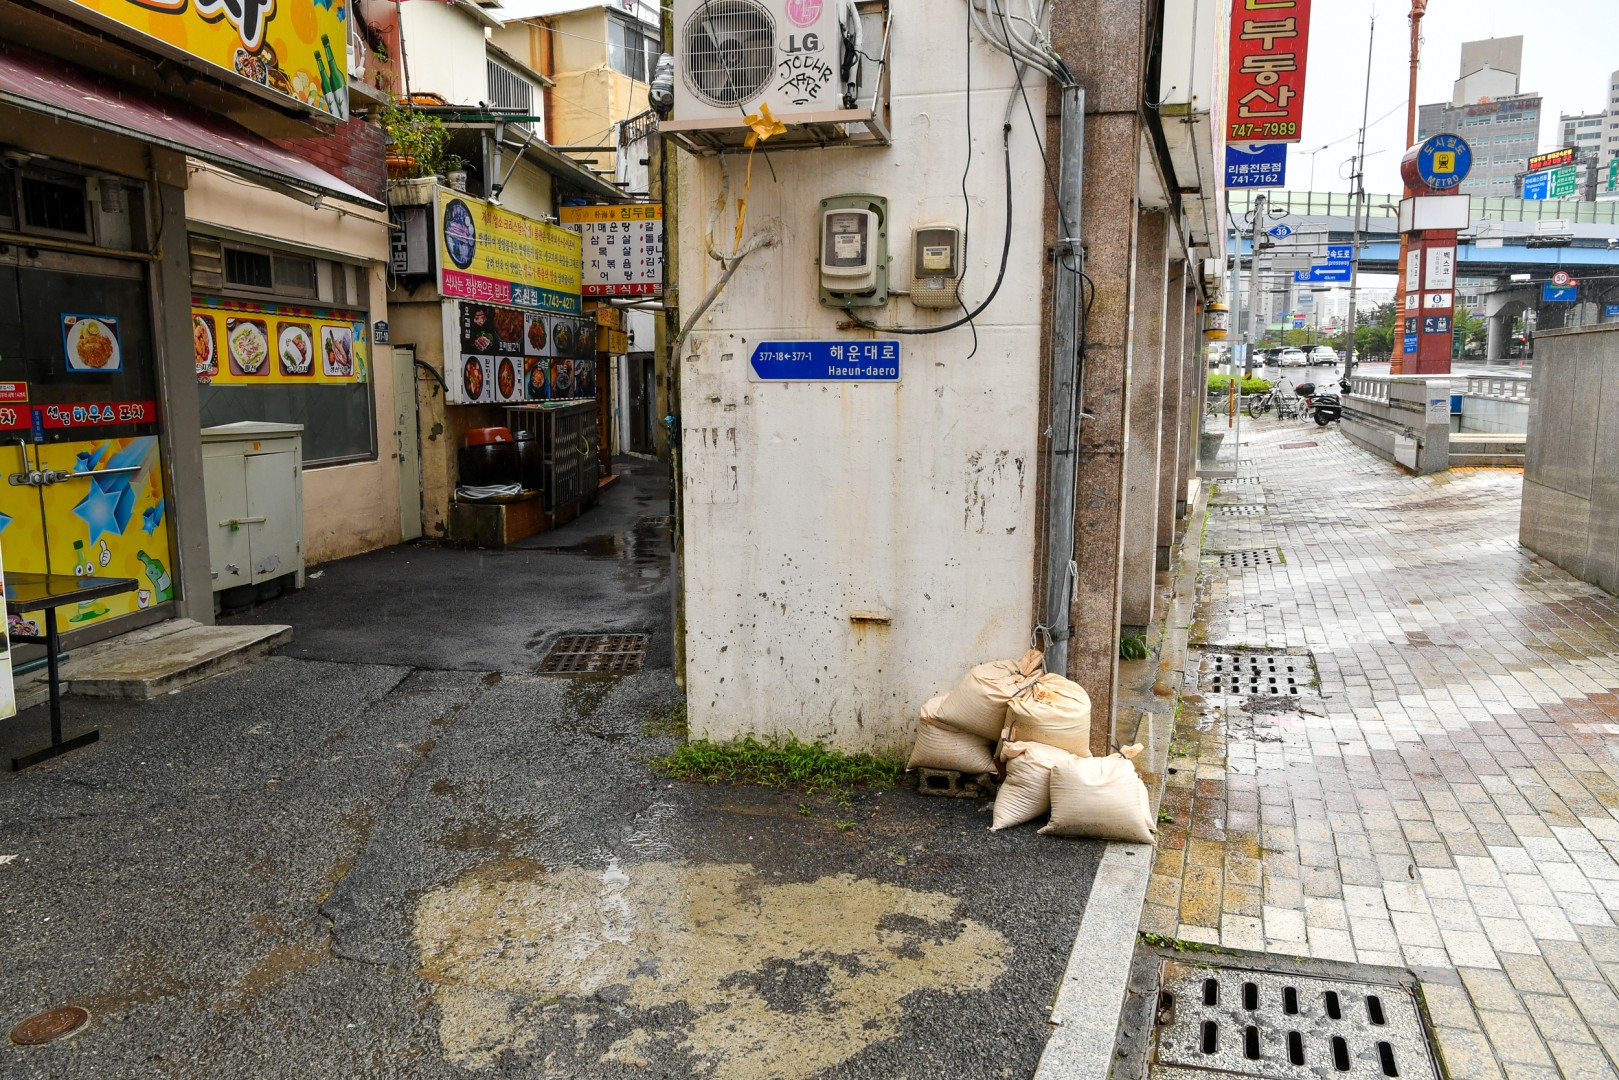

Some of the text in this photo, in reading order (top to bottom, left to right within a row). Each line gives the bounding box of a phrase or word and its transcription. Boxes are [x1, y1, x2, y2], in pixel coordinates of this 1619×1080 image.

[790, 33, 819, 54] LG
[1238, 17, 1298, 118] 부동산
[1231, 122, 1297, 137] 747-7989
[1424, 137, 1466, 156] 도시철도
[1231, 174, 1278, 185] 741-7162
[1426, 174, 1460, 188] METRO
[591, 235, 631, 245] 삼겹살
[1443, 252, 1451, 275] 벡스코
[445, 274, 511, 300] 식사는 정상적으로 됩니다
[514, 287, 576, 310] 초원집 T.743-4271
[464, 306, 472, 339] 오겹살
[759, 352, 812, 361] 377-18 377-1
[830, 345, 896, 362] 해운대로
[828, 366, 896, 376] Haeun-daero
[73, 404, 116, 424] 하우스
[119, 404, 145, 422] 포차
